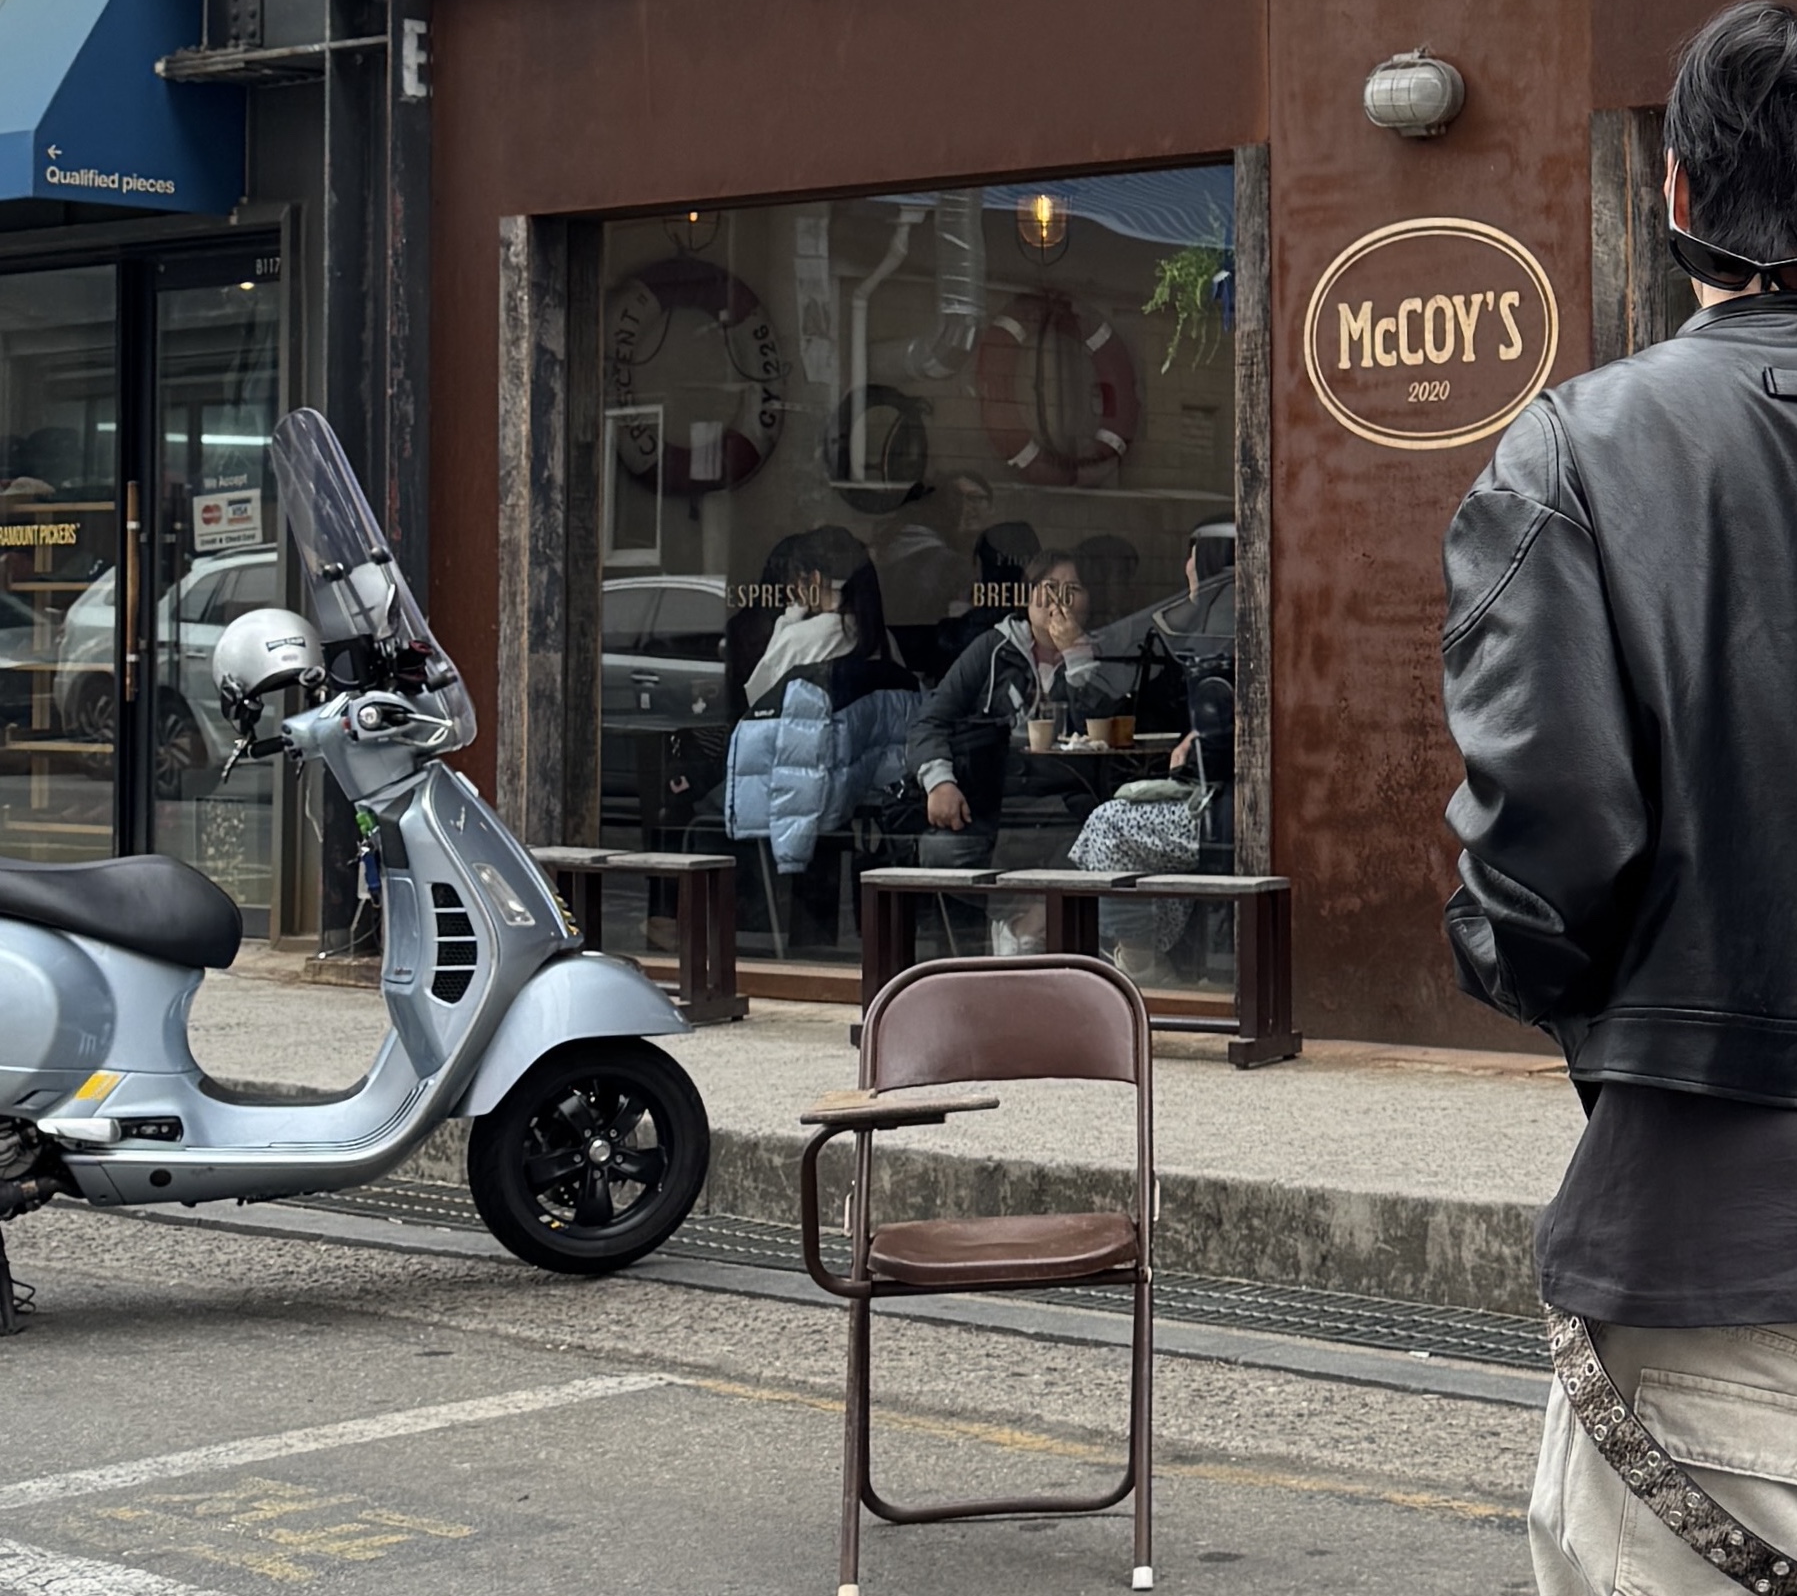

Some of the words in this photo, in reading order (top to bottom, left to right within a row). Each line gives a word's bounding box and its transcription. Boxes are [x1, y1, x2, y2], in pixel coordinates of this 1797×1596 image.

[46, 166, 118, 189] Qualified
[122, 173, 175, 194] pieces
[1338, 291, 1523, 369] McCOY'S
[752, 324, 781, 375] 226
[1408, 380, 1450, 402] 2020
[727, 584, 820, 608] ESPRESSO
[973, 580, 1075, 608] BREWING
